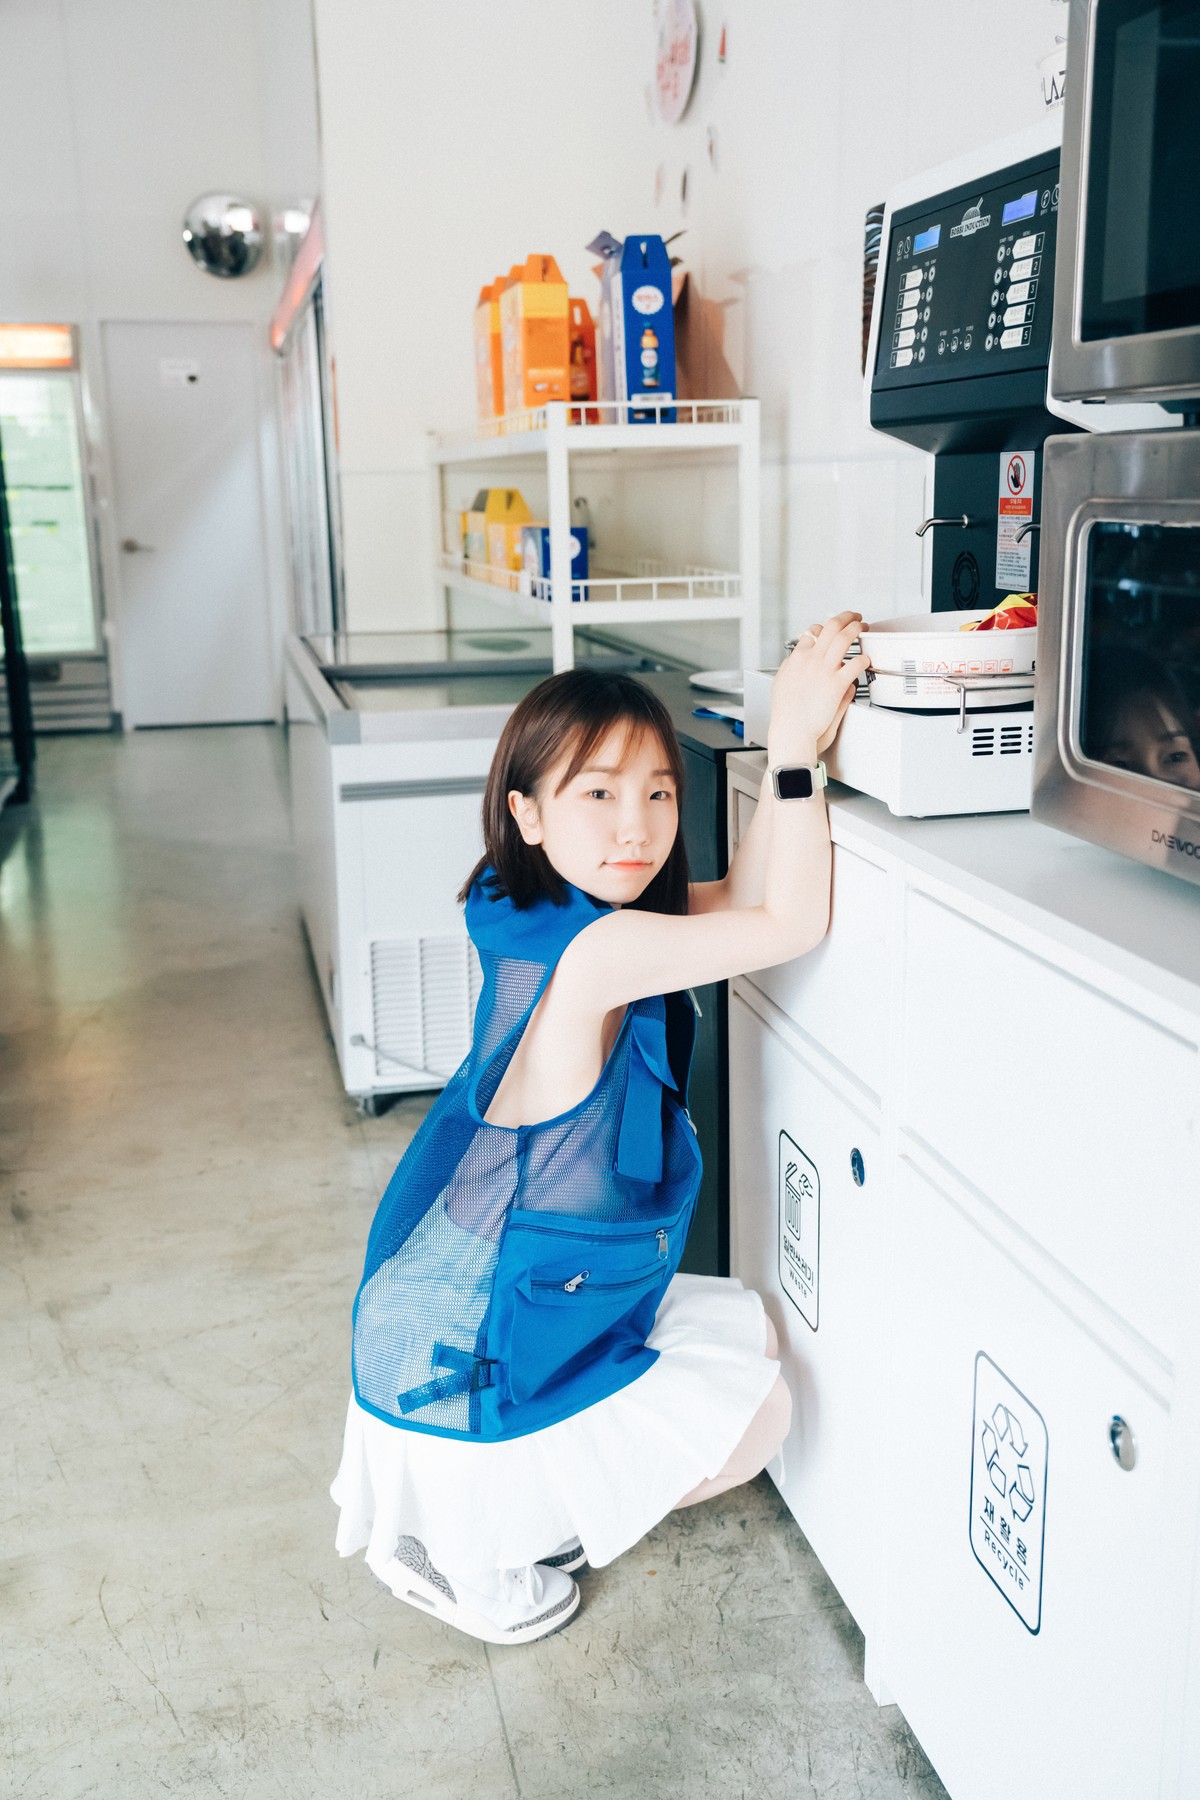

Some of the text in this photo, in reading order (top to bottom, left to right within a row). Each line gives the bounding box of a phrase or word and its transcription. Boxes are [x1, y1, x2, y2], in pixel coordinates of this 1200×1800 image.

[964, 216, 990, 232] INDUCTION
[783, 1234, 813, 1287] 일반쓰레기
[789, 1266, 807, 1298] Waste
[984, 1529, 1024, 1591] Recycle
